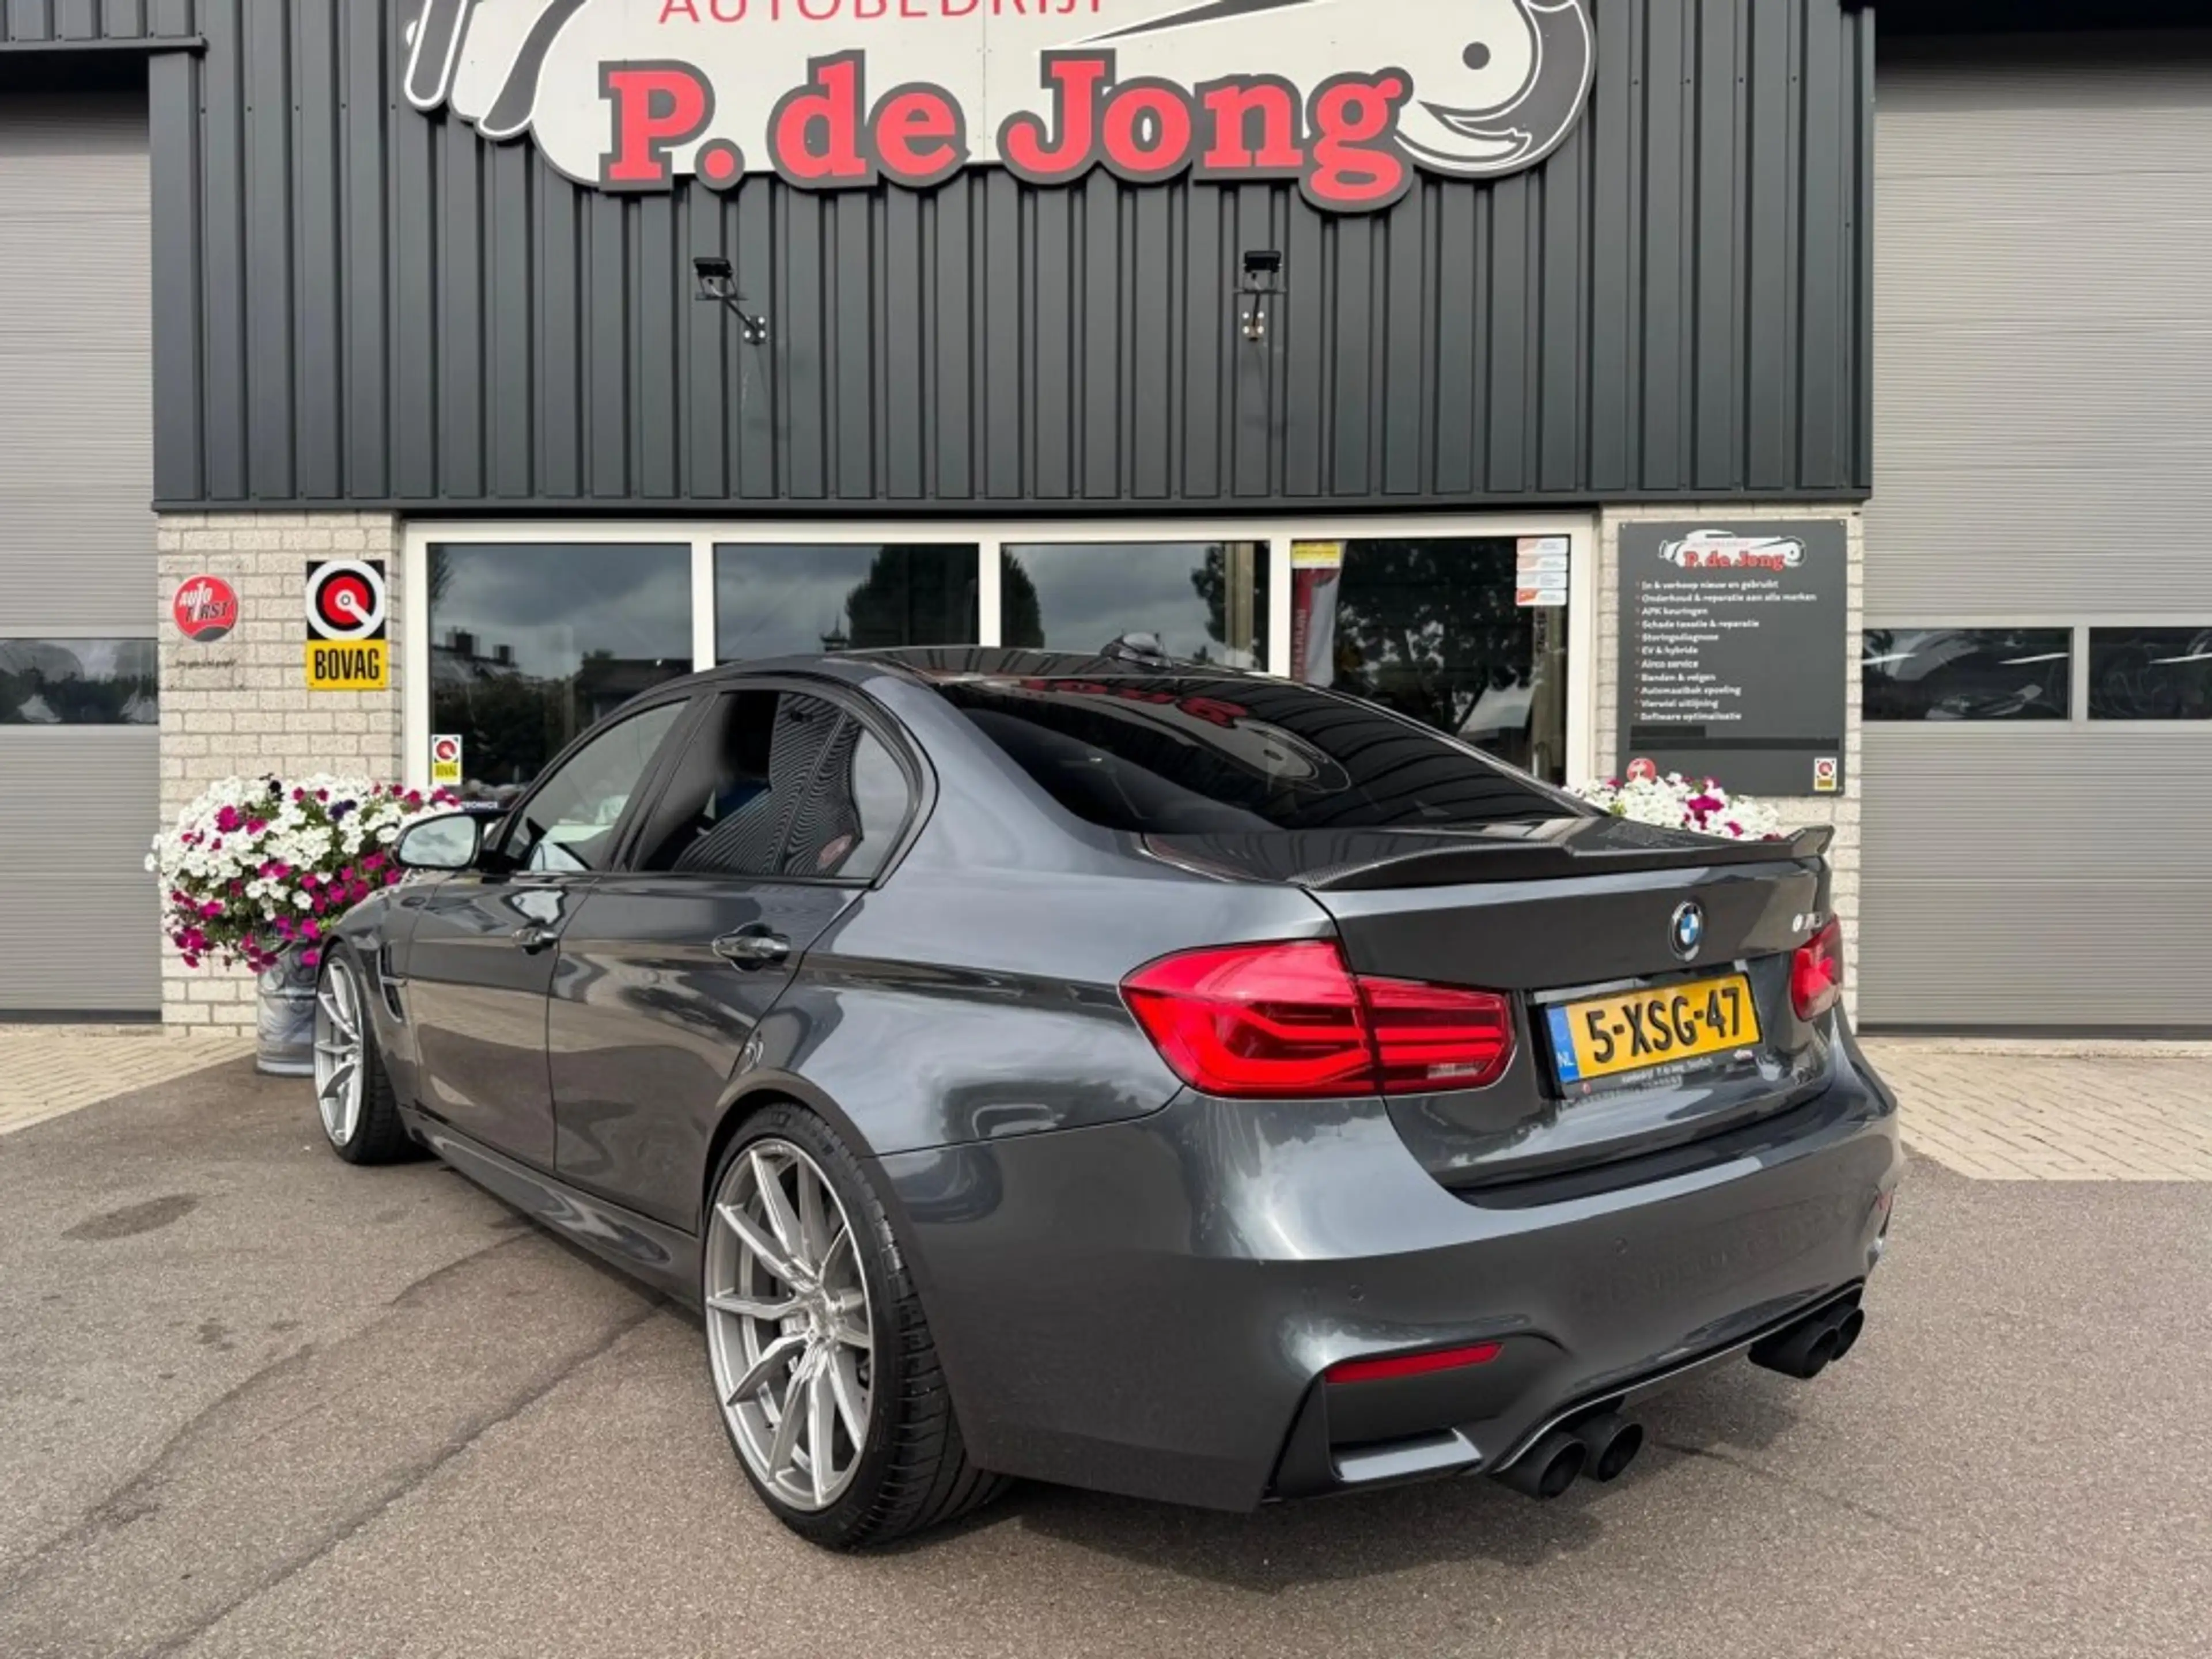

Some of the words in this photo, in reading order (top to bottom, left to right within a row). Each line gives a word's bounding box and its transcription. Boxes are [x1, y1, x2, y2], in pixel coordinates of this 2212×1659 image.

[602, 63, 740, 186] P.
[771, 55, 963, 183] de
[1001, 54, 1408, 207] Jong
[1684, 551, 1702, 568] P.
[1706, 550, 1730, 568] de
[1734, 550, 1785, 571] Jong
[1662, 581, 1699, 592] verkoop
[1741, 579, 1779, 590] gebruikt
[1642, 593, 1692, 603] Onderhoud
[1695, 593, 1701, 601] &
[1703, 594, 1744, 604] reparatie
[1642, 607, 1662, 616] APK
[1663, 606, 1708, 617] keuringen
[1642, 620, 1674, 629] Schade
[1709, 619, 1716, 627] &
[1718, 619, 1759, 629] reparatie
[1642, 632, 1719, 644] Storingsdiagnose
[1642, 646, 1654, 655] EV
[1656, 646, 1662, 654] &
[314, 648, 380, 680] BOVAG
[1641, 659, 1665, 668] Airco
[1667, 660, 1699, 668] service
[1641, 673, 1676, 681] Banden
[1678, 673, 1685, 681] &
[1687, 673, 1716, 683] velgen
[1703, 685, 1741, 696] spoeling
[1640, 712, 1681, 721] Software
[1683, 711, 1742, 723] optimalisatie
[1586, 987, 1740, 1064] 5-XSG-47
[1557, 1051, 1574, 1069] NL
